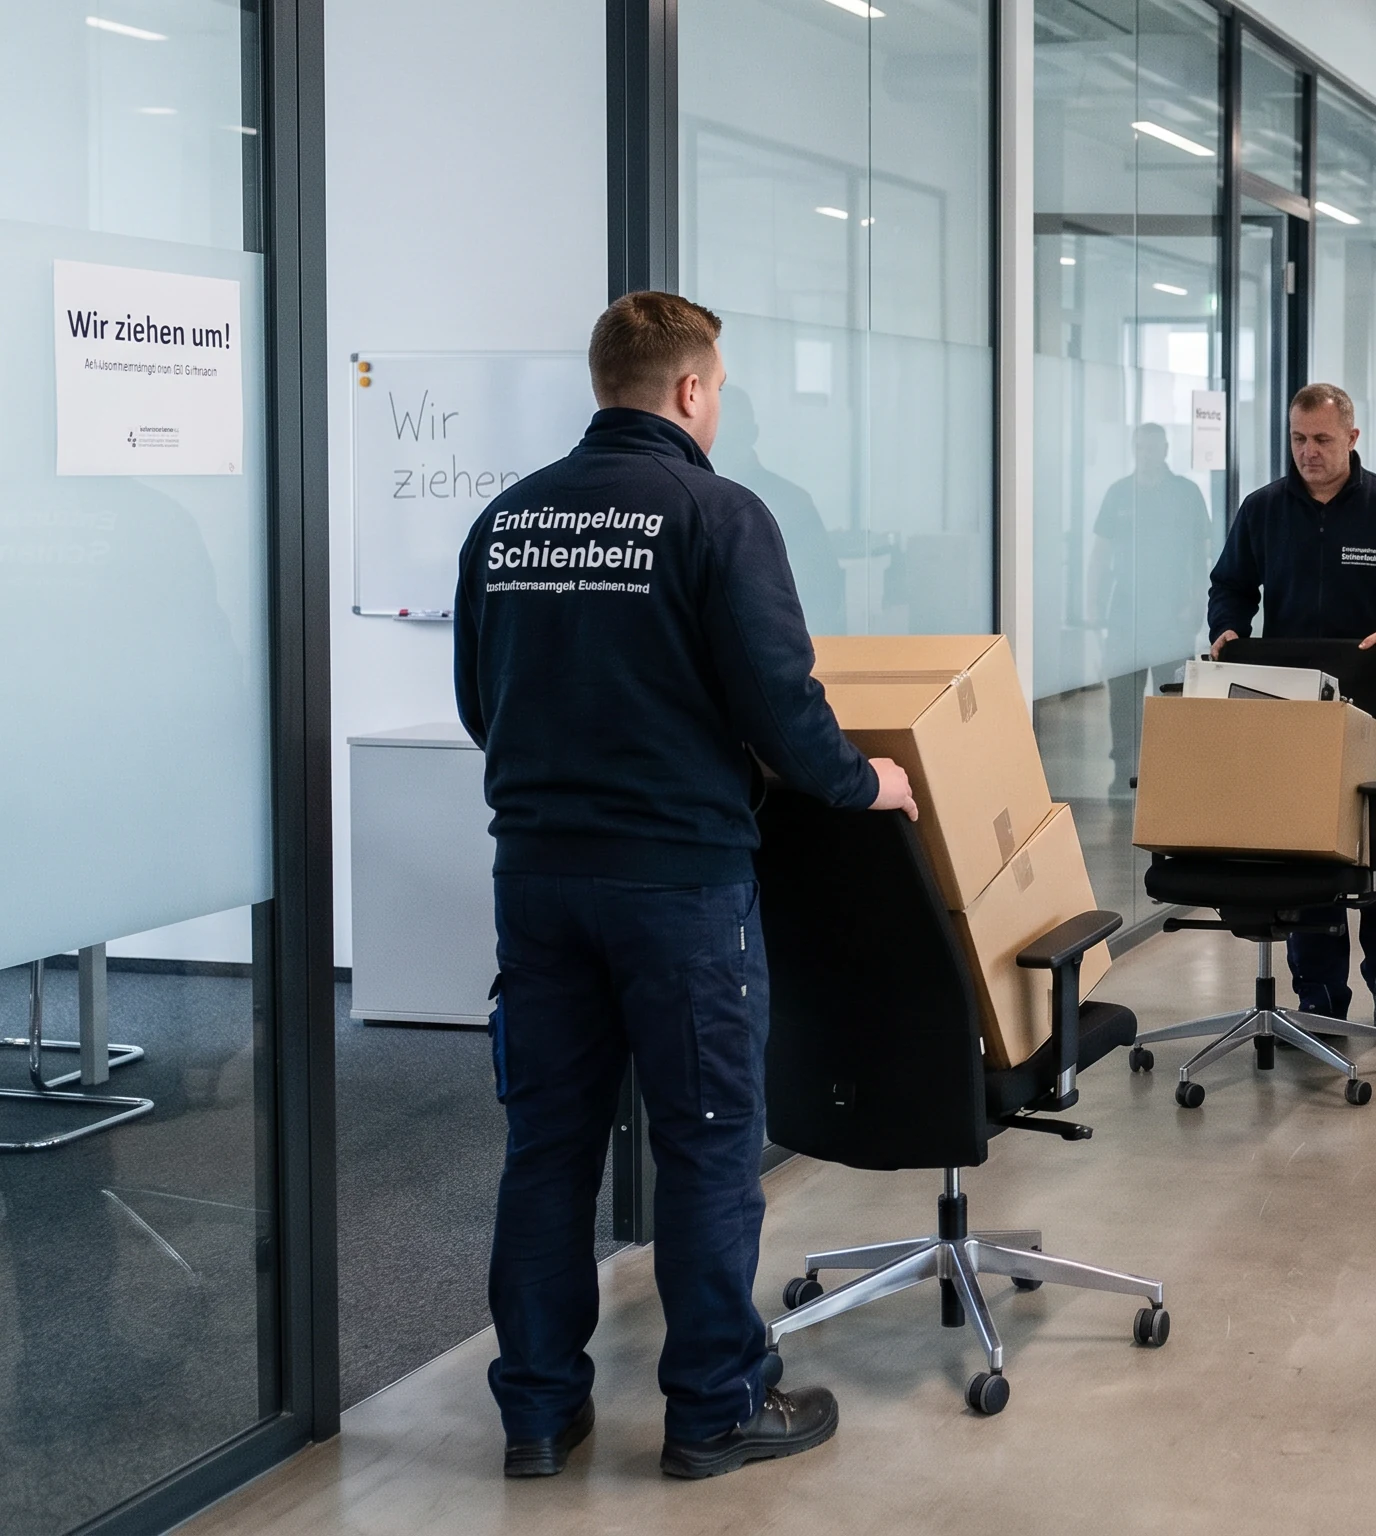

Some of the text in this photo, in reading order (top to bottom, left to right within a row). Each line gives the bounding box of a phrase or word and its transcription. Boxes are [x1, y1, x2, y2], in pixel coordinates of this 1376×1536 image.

[67, 309, 230, 350] Wir ziehen um!
[388, 389, 459, 442] Wir
[492, 506, 664, 537] Entrümpelung
[487, 539, 654, 571] Schienbein
